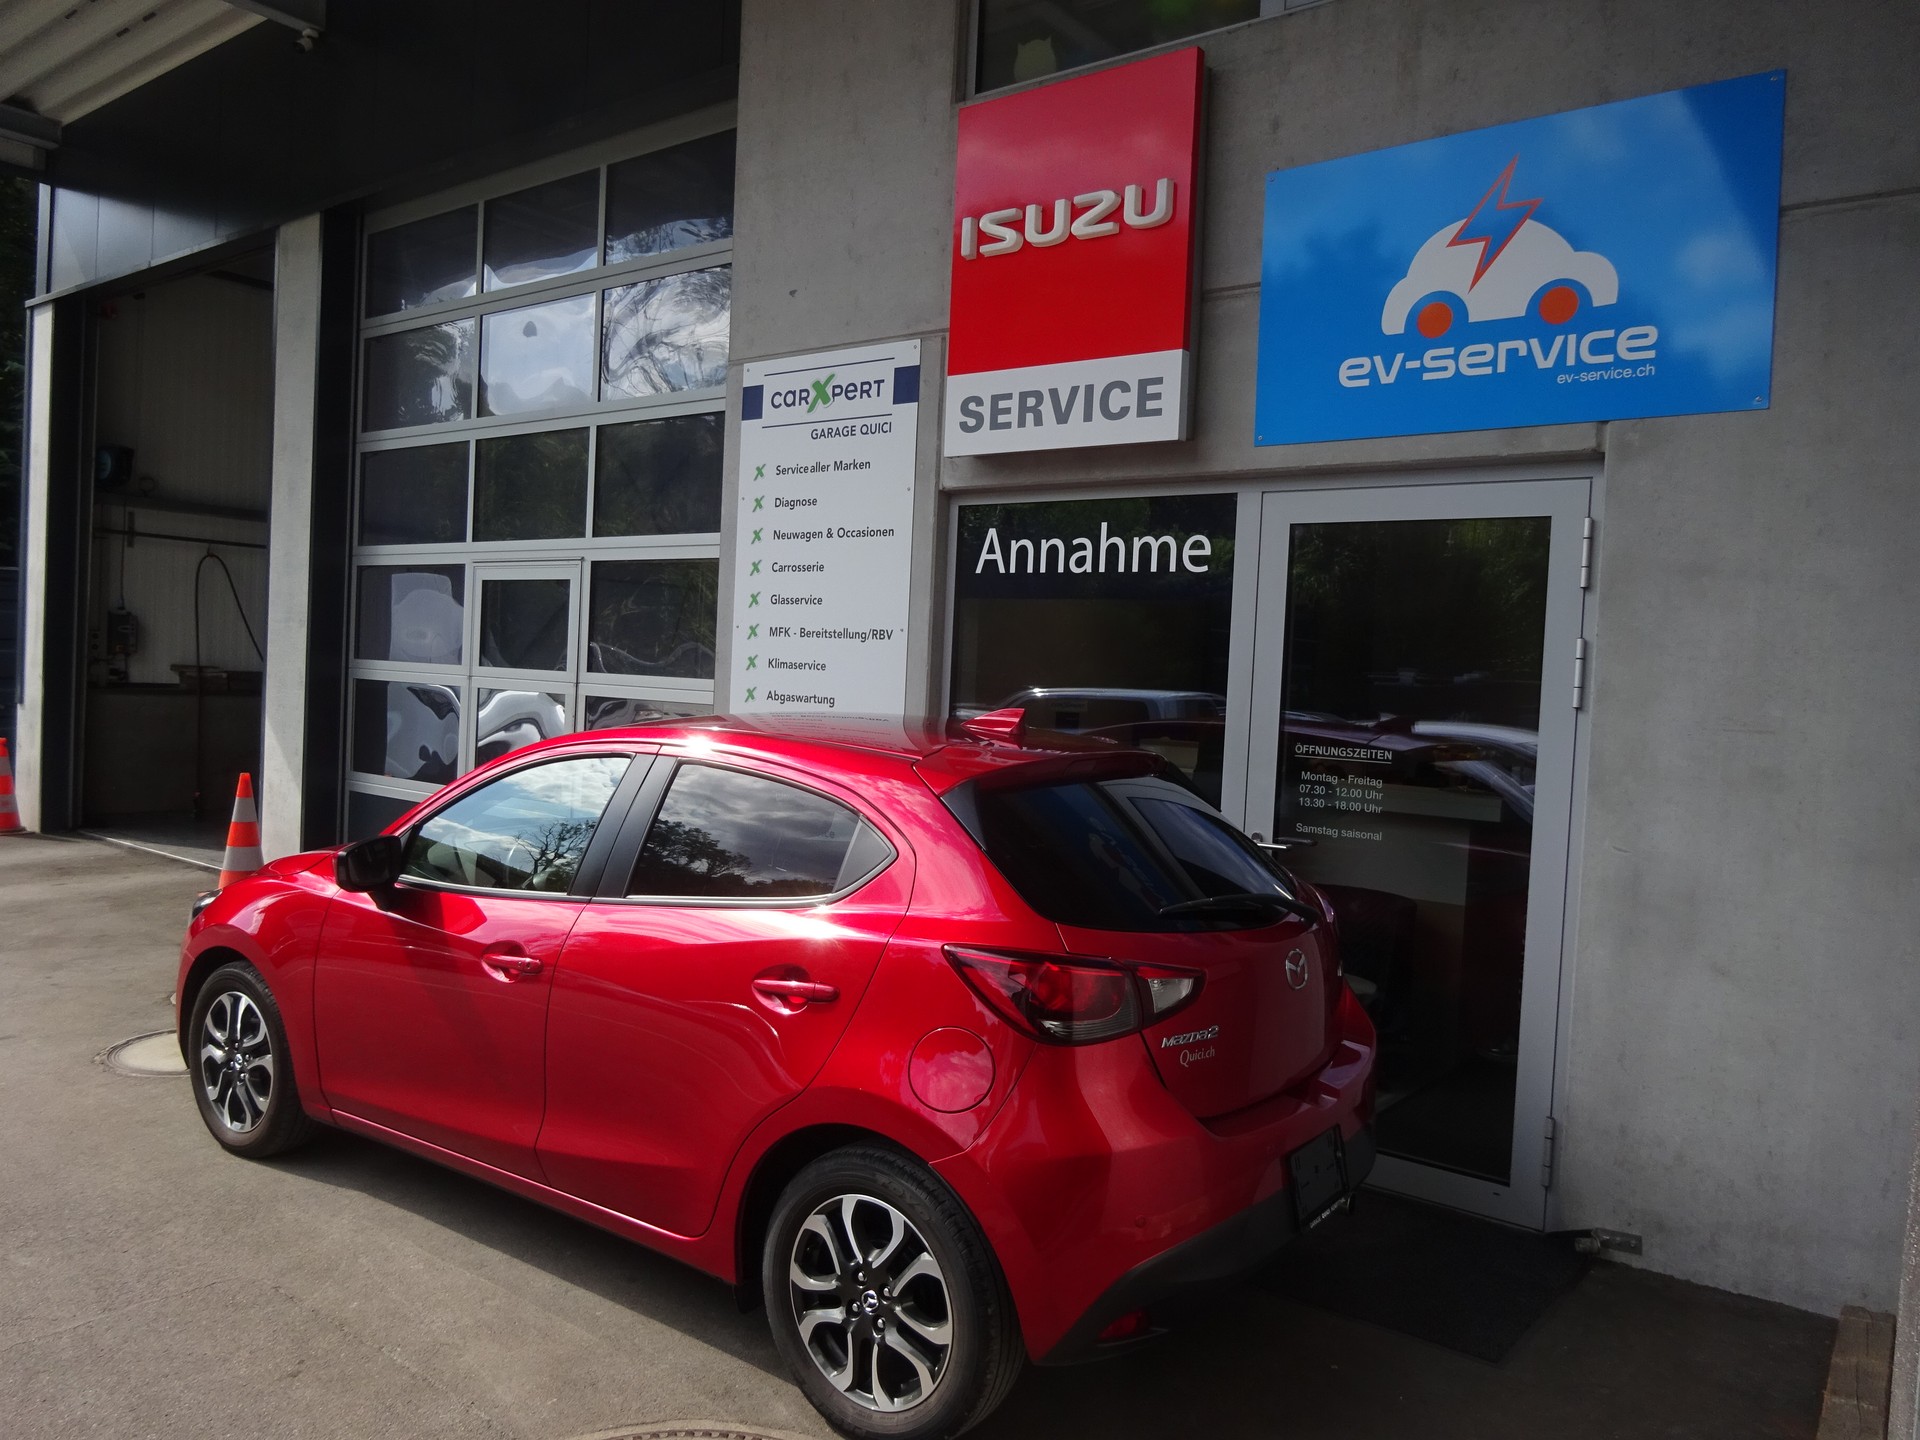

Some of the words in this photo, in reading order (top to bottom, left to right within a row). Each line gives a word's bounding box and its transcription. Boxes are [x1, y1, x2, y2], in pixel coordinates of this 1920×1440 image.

[961, 178, 1174, 260] ISUZU
[1338, 325, 1658, 388] ev-service
[1557, 363, 1655, 384] ev-service.ch
[959, 376, 1164, 434] SERVICE
[810, 425, 857, 440] GARAGE
[860, 422, 892, 435] QUICI
[775, 463, 809, 476] Service
[810, 461, 831, 473] aller
[833, 459, 871, 471] Marken
[774, 497, 818, 511] Diagnose
[773, 530, 823, 542] Neuwagen
[826, 528, 834, 539] &
[837, 526, 895, 539] Occasionen
[975, 521, 1212, 574] Annahme
[771, 561, 825, 573] Carrosserie
[770, 594, 823, 605] Glasservice
[769, 627, 791, 638] MFK
[799, 627, 893, 643] Bereitstellung/RBV
[768, 658, 827, 671] Klimaservice
[766, 690, 835, 708] Abgaswartung
[1295, 743, 1393, 761] ÖFFNUNGSZEITEN
[1301, 771, 1338, 785] Montag
[1348, 775, 1383, 789] Freitag
[1299, 784, 1326, 795] 07.30
[1335, 787, 1362, 798] 12.00
[1364, 790, 1384, 800] Uhr
[1299, 797, 1325, 808] 13.30
[1335, 801, 1362, 811] 18.00
[1364, 803, 1383, 813] Uhr
[1295, 823, 1339, 838] Samstag
[1341, 830, 1383, 841] saisonal
[1179, 1045, 1216, 1068] Quici.ch
